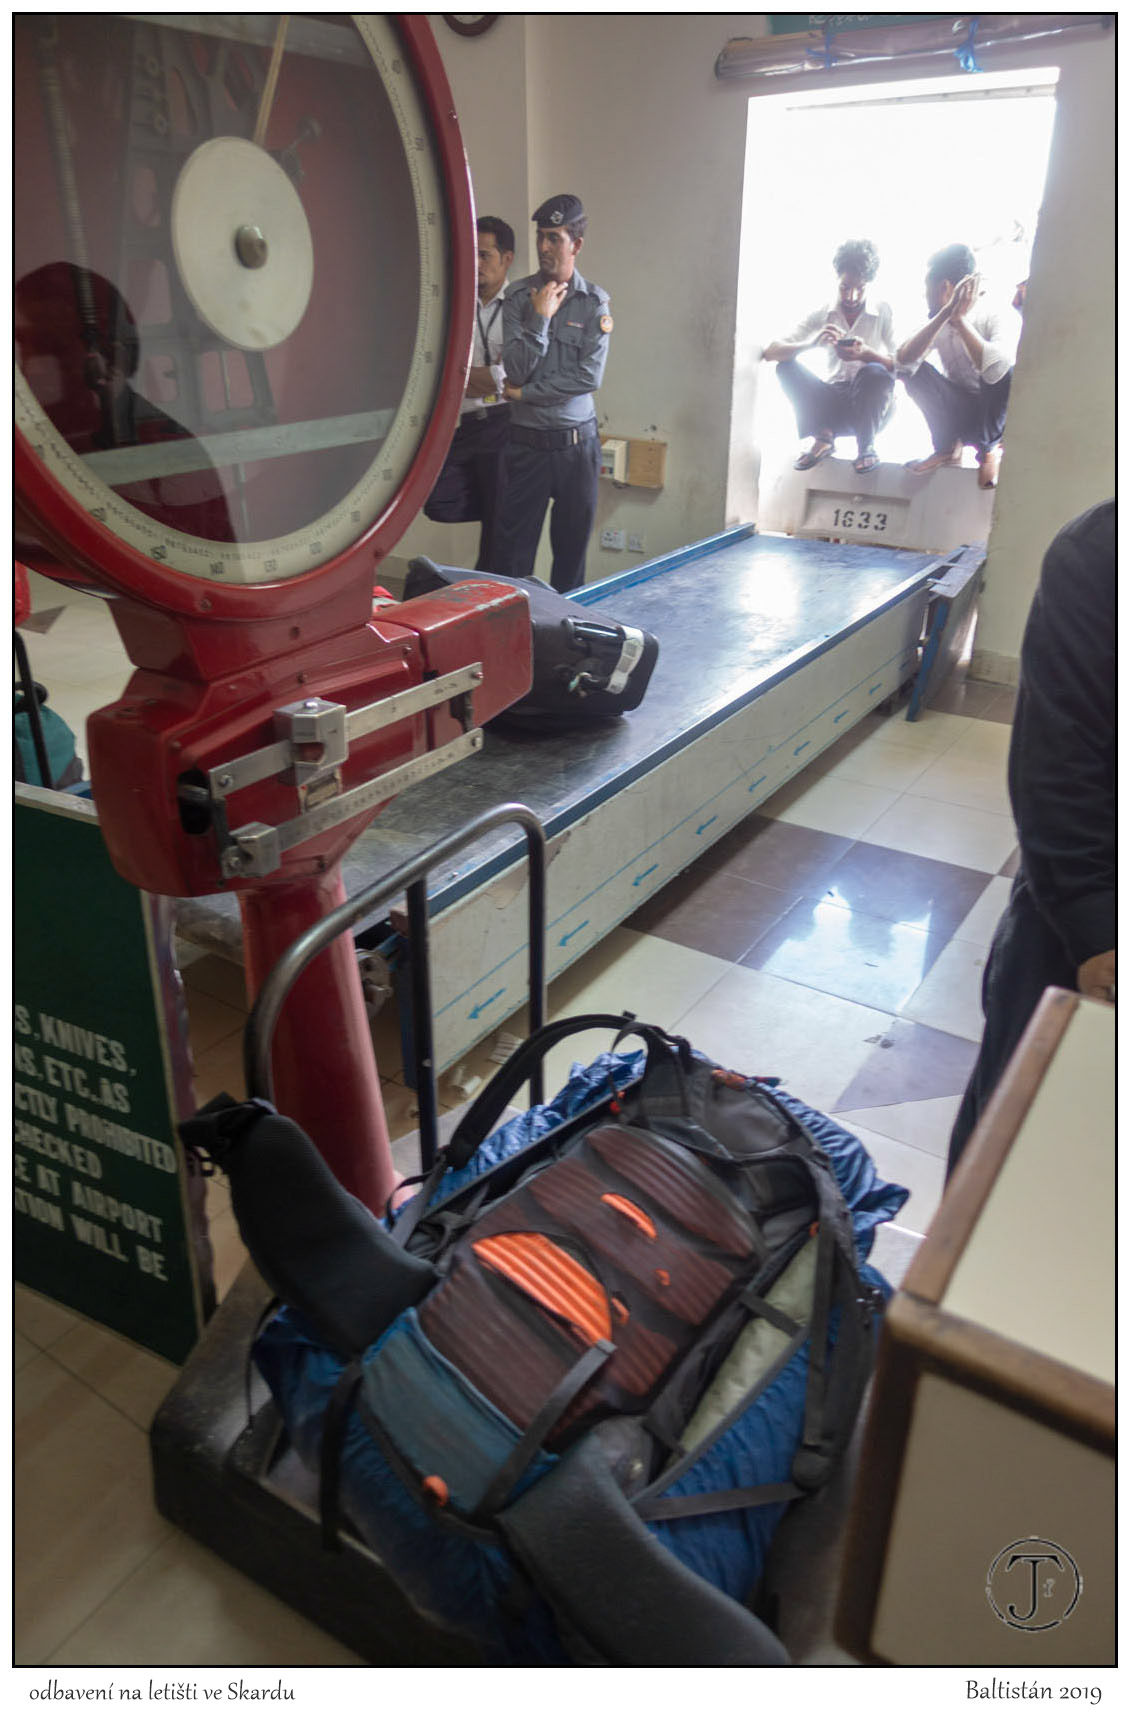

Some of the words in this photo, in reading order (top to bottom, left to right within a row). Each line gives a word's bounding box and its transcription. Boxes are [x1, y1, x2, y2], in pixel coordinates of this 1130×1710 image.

[834, 508, 888, 531] 1633
[64, 1103, 177, 1174] PROHIBITED
[37, 1164, 61, 1197] AT
[71, 1180, 163, 1243] AIRPORT
[70, 1214, 129, 1263] WILL
[136, 1244, 168, 1281] BE
